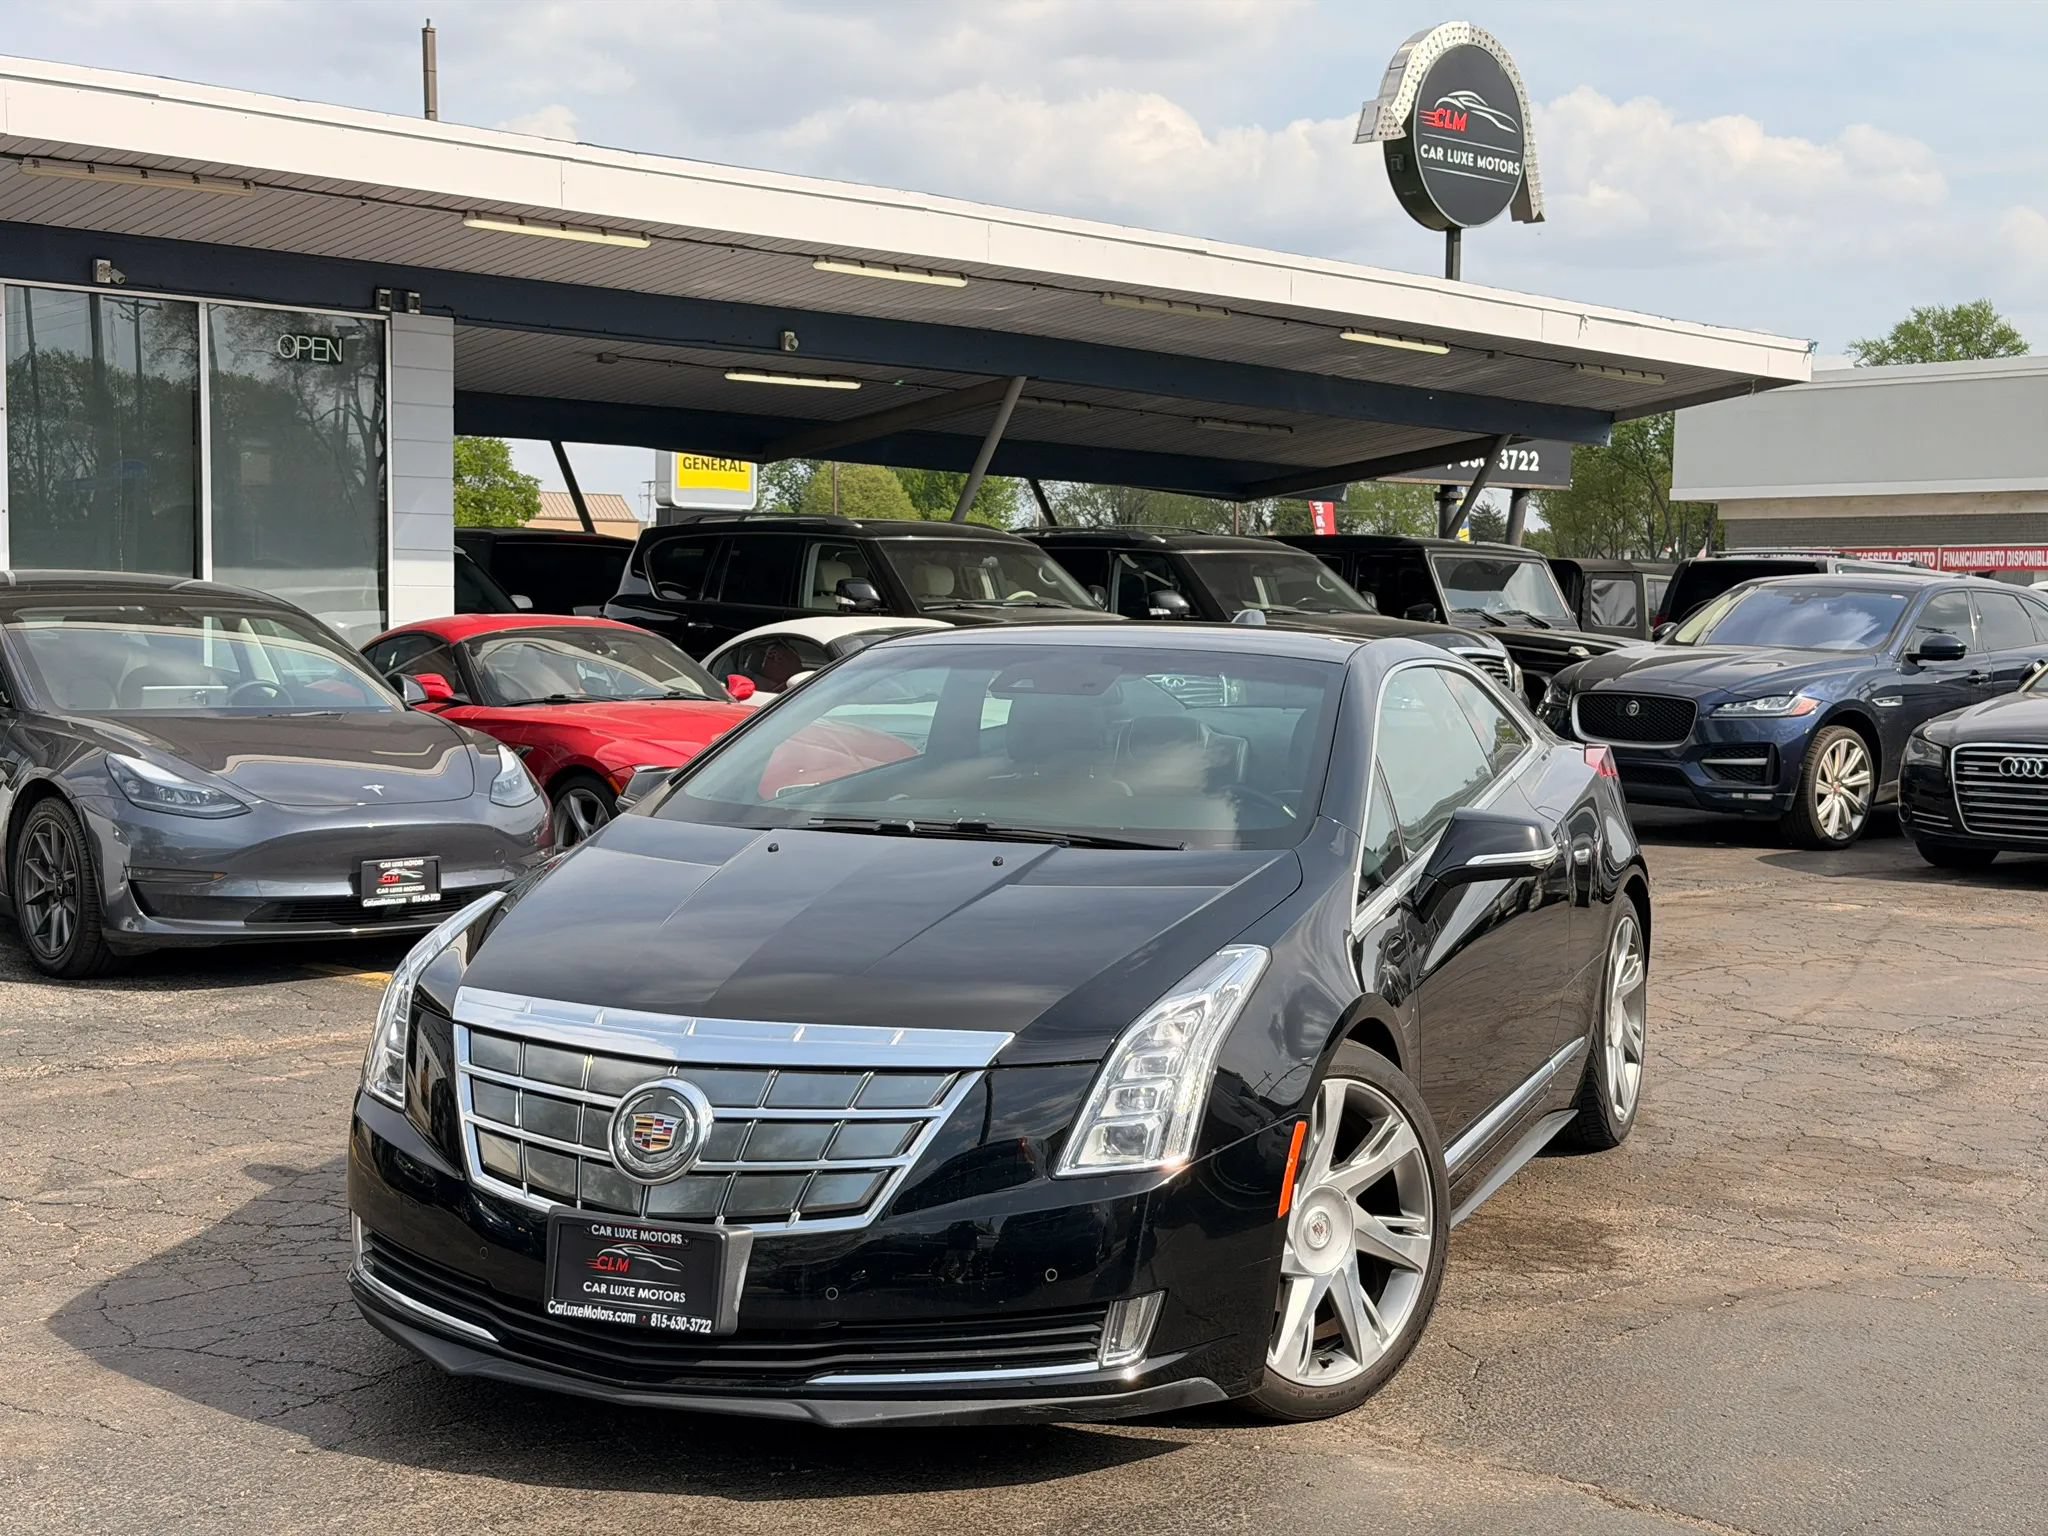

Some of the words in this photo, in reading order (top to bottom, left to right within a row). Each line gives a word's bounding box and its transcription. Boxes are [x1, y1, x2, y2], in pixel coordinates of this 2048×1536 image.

[1434, 108, 1468, 131] CLM
[1420, 144, 1444, 160] CAR
[1447, 149, 1474, 166] LUXE
[1477, 154, 1520, 175] MOTORS
[278, 334, 343, 362] OPEN
[682, 456, 746, 473] GENERAL
[1895, 551, 1936, 568] CREDITO
[1942, 550, 2005, 567] FINANCIAMIENTO
[591, 1224, 612, 1237] CAR
[614, 1227, 637, 1240] LUXE
[640, 1229, 682, 1245] MOTORS
[597, 1256, 630, 1272] CLM
[583, 1281, 607, 1294] CAR
[609, 1284, 635, 1298] LUXE
[637, 1288, 686, 1303] MOTORS
[547, 1300, 637, 1325] CarLuxeMotors.com
[650, 1312, 712, 1334] 815-630-3722
